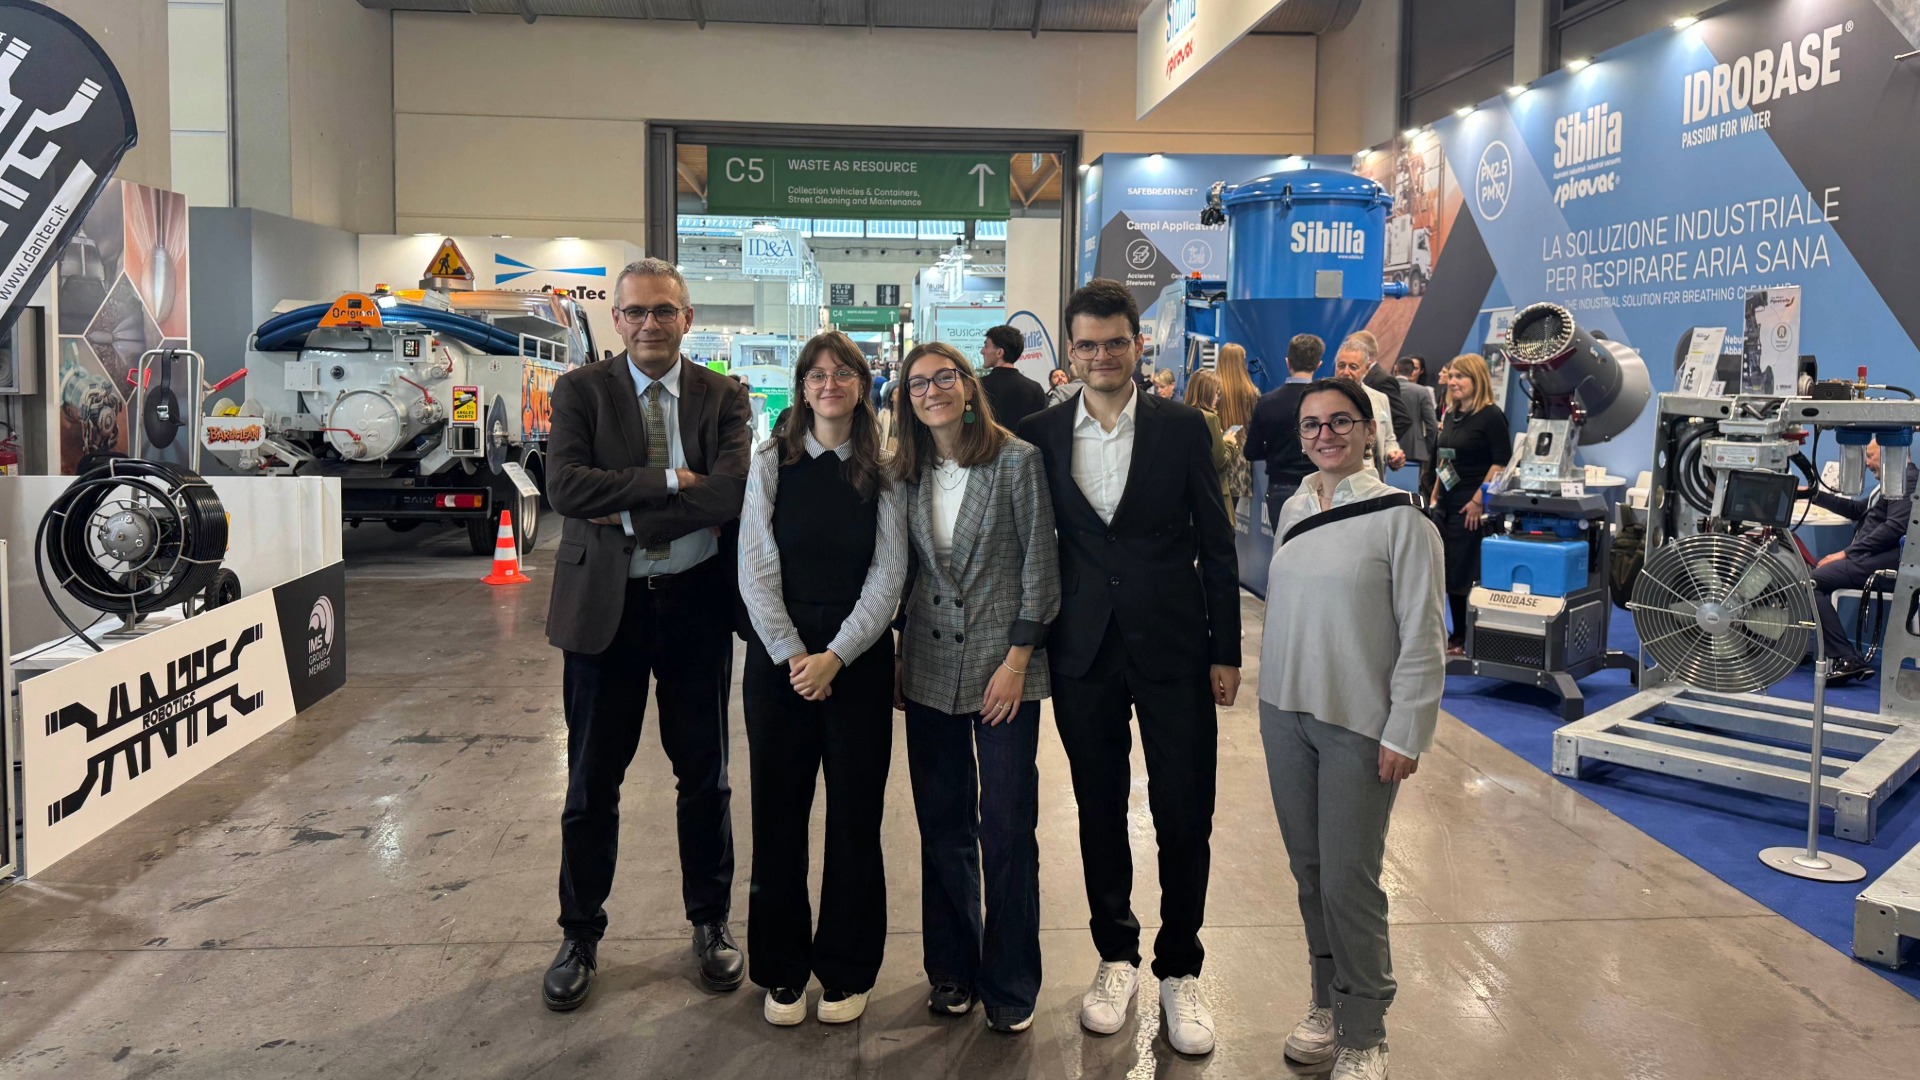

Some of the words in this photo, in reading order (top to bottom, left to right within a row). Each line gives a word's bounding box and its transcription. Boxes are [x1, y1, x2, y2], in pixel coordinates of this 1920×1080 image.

[1683, 23, 1843, 125] IDROBASE
[1554, 102, 1622, 169] Sibilia
[1682, 124, 1718, 149] PASSION
[1719, 119, 1738, 139] FOR
[1740, 110, 1771, 134] WATER
[725, 157, 765, 183] C5
[788, 159, 830, 171] WASTE
[833, 160, 850, 171] AS
[853, 161, 918, 173] RESOURCE
[1480, 158, 1508, 182] PM2.5
[788, 186, 828, 195] Collection
[830, 187, 864, 196] Vehicles
[866, 188, 872, 196] &
[874, 188, 920, 198] Containers,
[788, 195, 813, 204] Street
[814, 196, 850, 206] Cleaning
[850, 197, 868, 205] and
[869, 197, 922, 206] Maintenance
[1553, 171, 1616, 208] spirovac
[1126, 221, 1159, 232] Campi
[1543, 235, 1562, 261] LA
[1565, 216, 1668, 258] SOLUZIONE
[1674, 186, 1841, 243] INDUSTRIALE
[748, 238, 794, 257] ID&A
[1290, 221, 1365, 254] Sibilia
[0, 204, 69, 301] www.dantec.it
[1546, 266, 1577, 293] PER
[1581, 251, 1688, 289] RESPIRARE
[1692, 244, 1748, 279] ARIA
[1755, 234, 1831, 274] SANA
[1565, 299, 1577, 310] THE
[1579, 296, 1620, 310] INDUSTRIAL
[1621, 292, 1661, 307] SOLUTION
[1663, 290, 1680, 304] FOR
[1682, 287, 1735, 304] BREATHING
[332, 307, 375, 319] Original
[949, 328, 987, 337] BUSIGRO
[403, 496, 435, 504] DAILY
[1489, 593, 1540, 607] IDROBASE
[308, 633, 323, 654] IMS
[308, 648, 327, 665] GROUP
[308, 657, 331, 677] MEMBER
[142, 690, 196, 730] ROBOTICS
